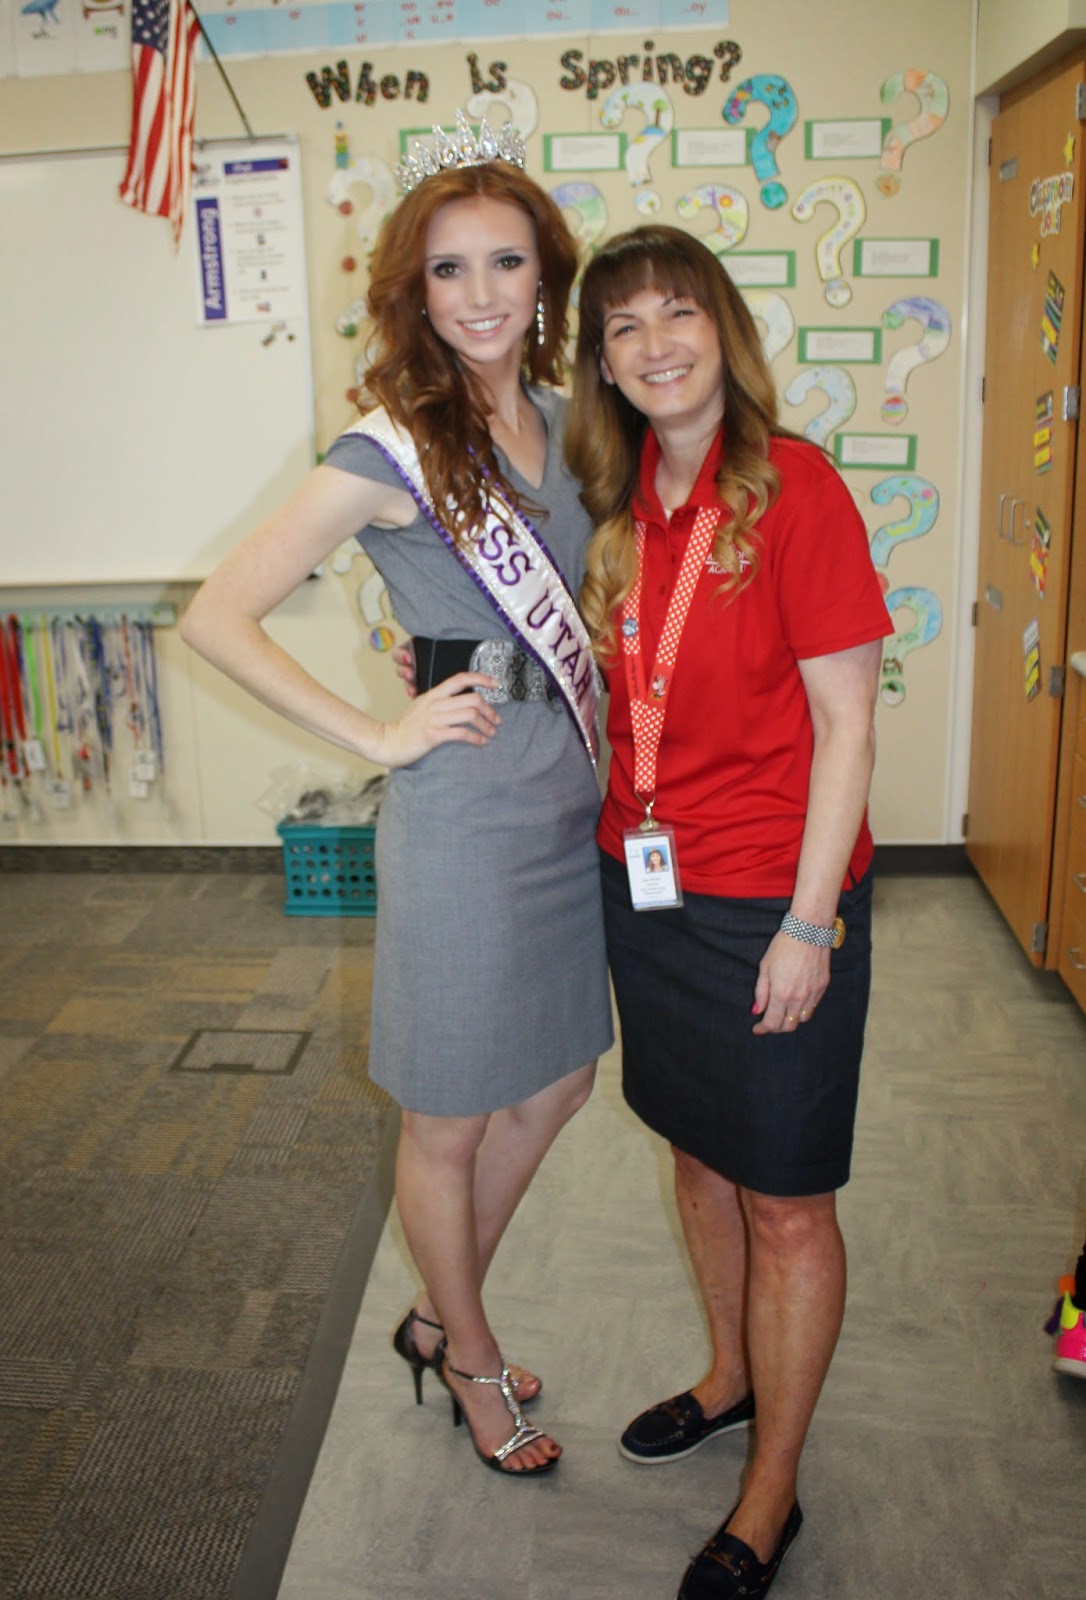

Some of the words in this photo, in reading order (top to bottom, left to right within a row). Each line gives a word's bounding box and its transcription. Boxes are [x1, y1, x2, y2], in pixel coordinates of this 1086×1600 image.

[306, 59, 430, 109] When
[560, 40, 743, 100] Spring?
[199, 207, 223, 311] Armstrong
